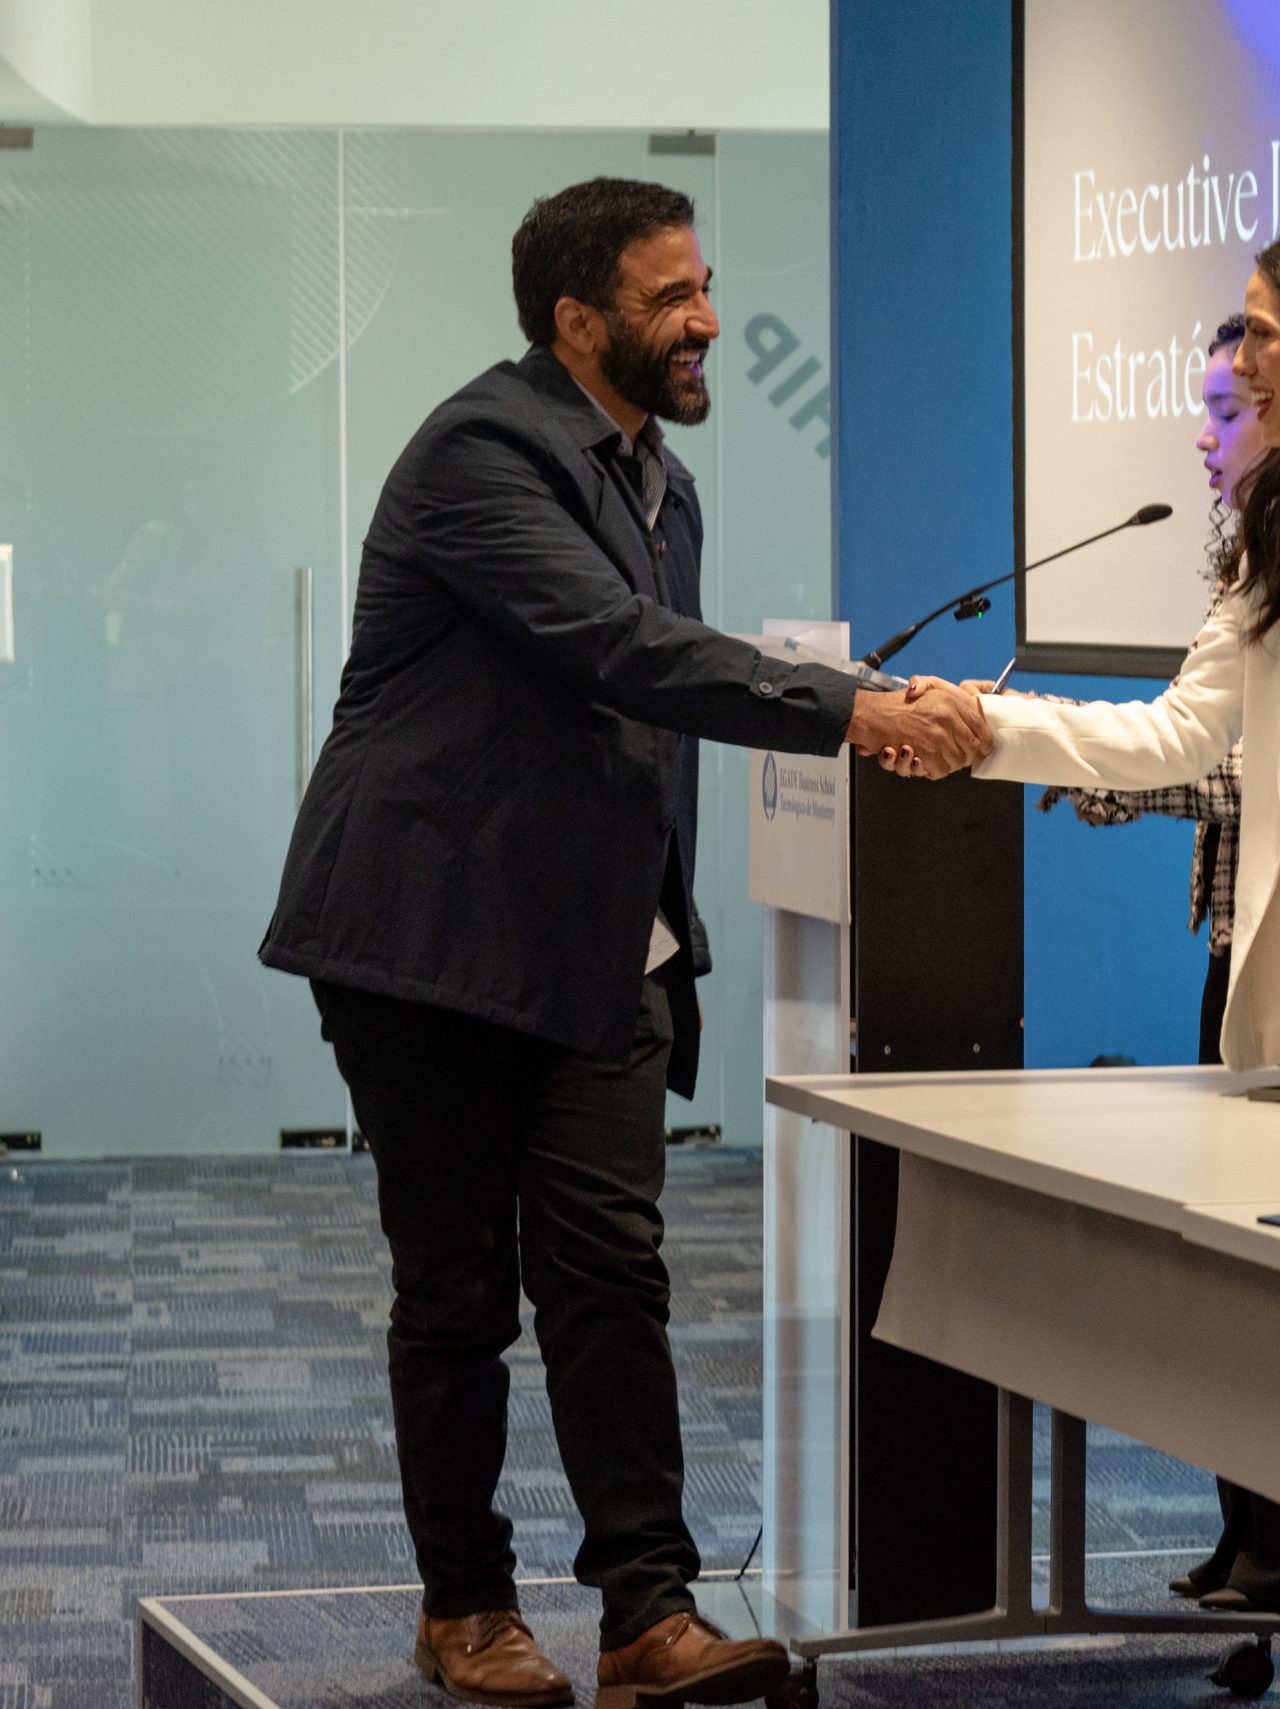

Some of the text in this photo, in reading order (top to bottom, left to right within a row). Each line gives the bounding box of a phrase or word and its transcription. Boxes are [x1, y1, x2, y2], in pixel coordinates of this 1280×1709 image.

[1073, 153, 1259, 263] Executive
[1071, 320, 1207, 423] Estraté
[779, 768, 836, 797] EGADE Business School
[805, 799, 812, 817] de
[812, 799, 836, 824] Monterrey
